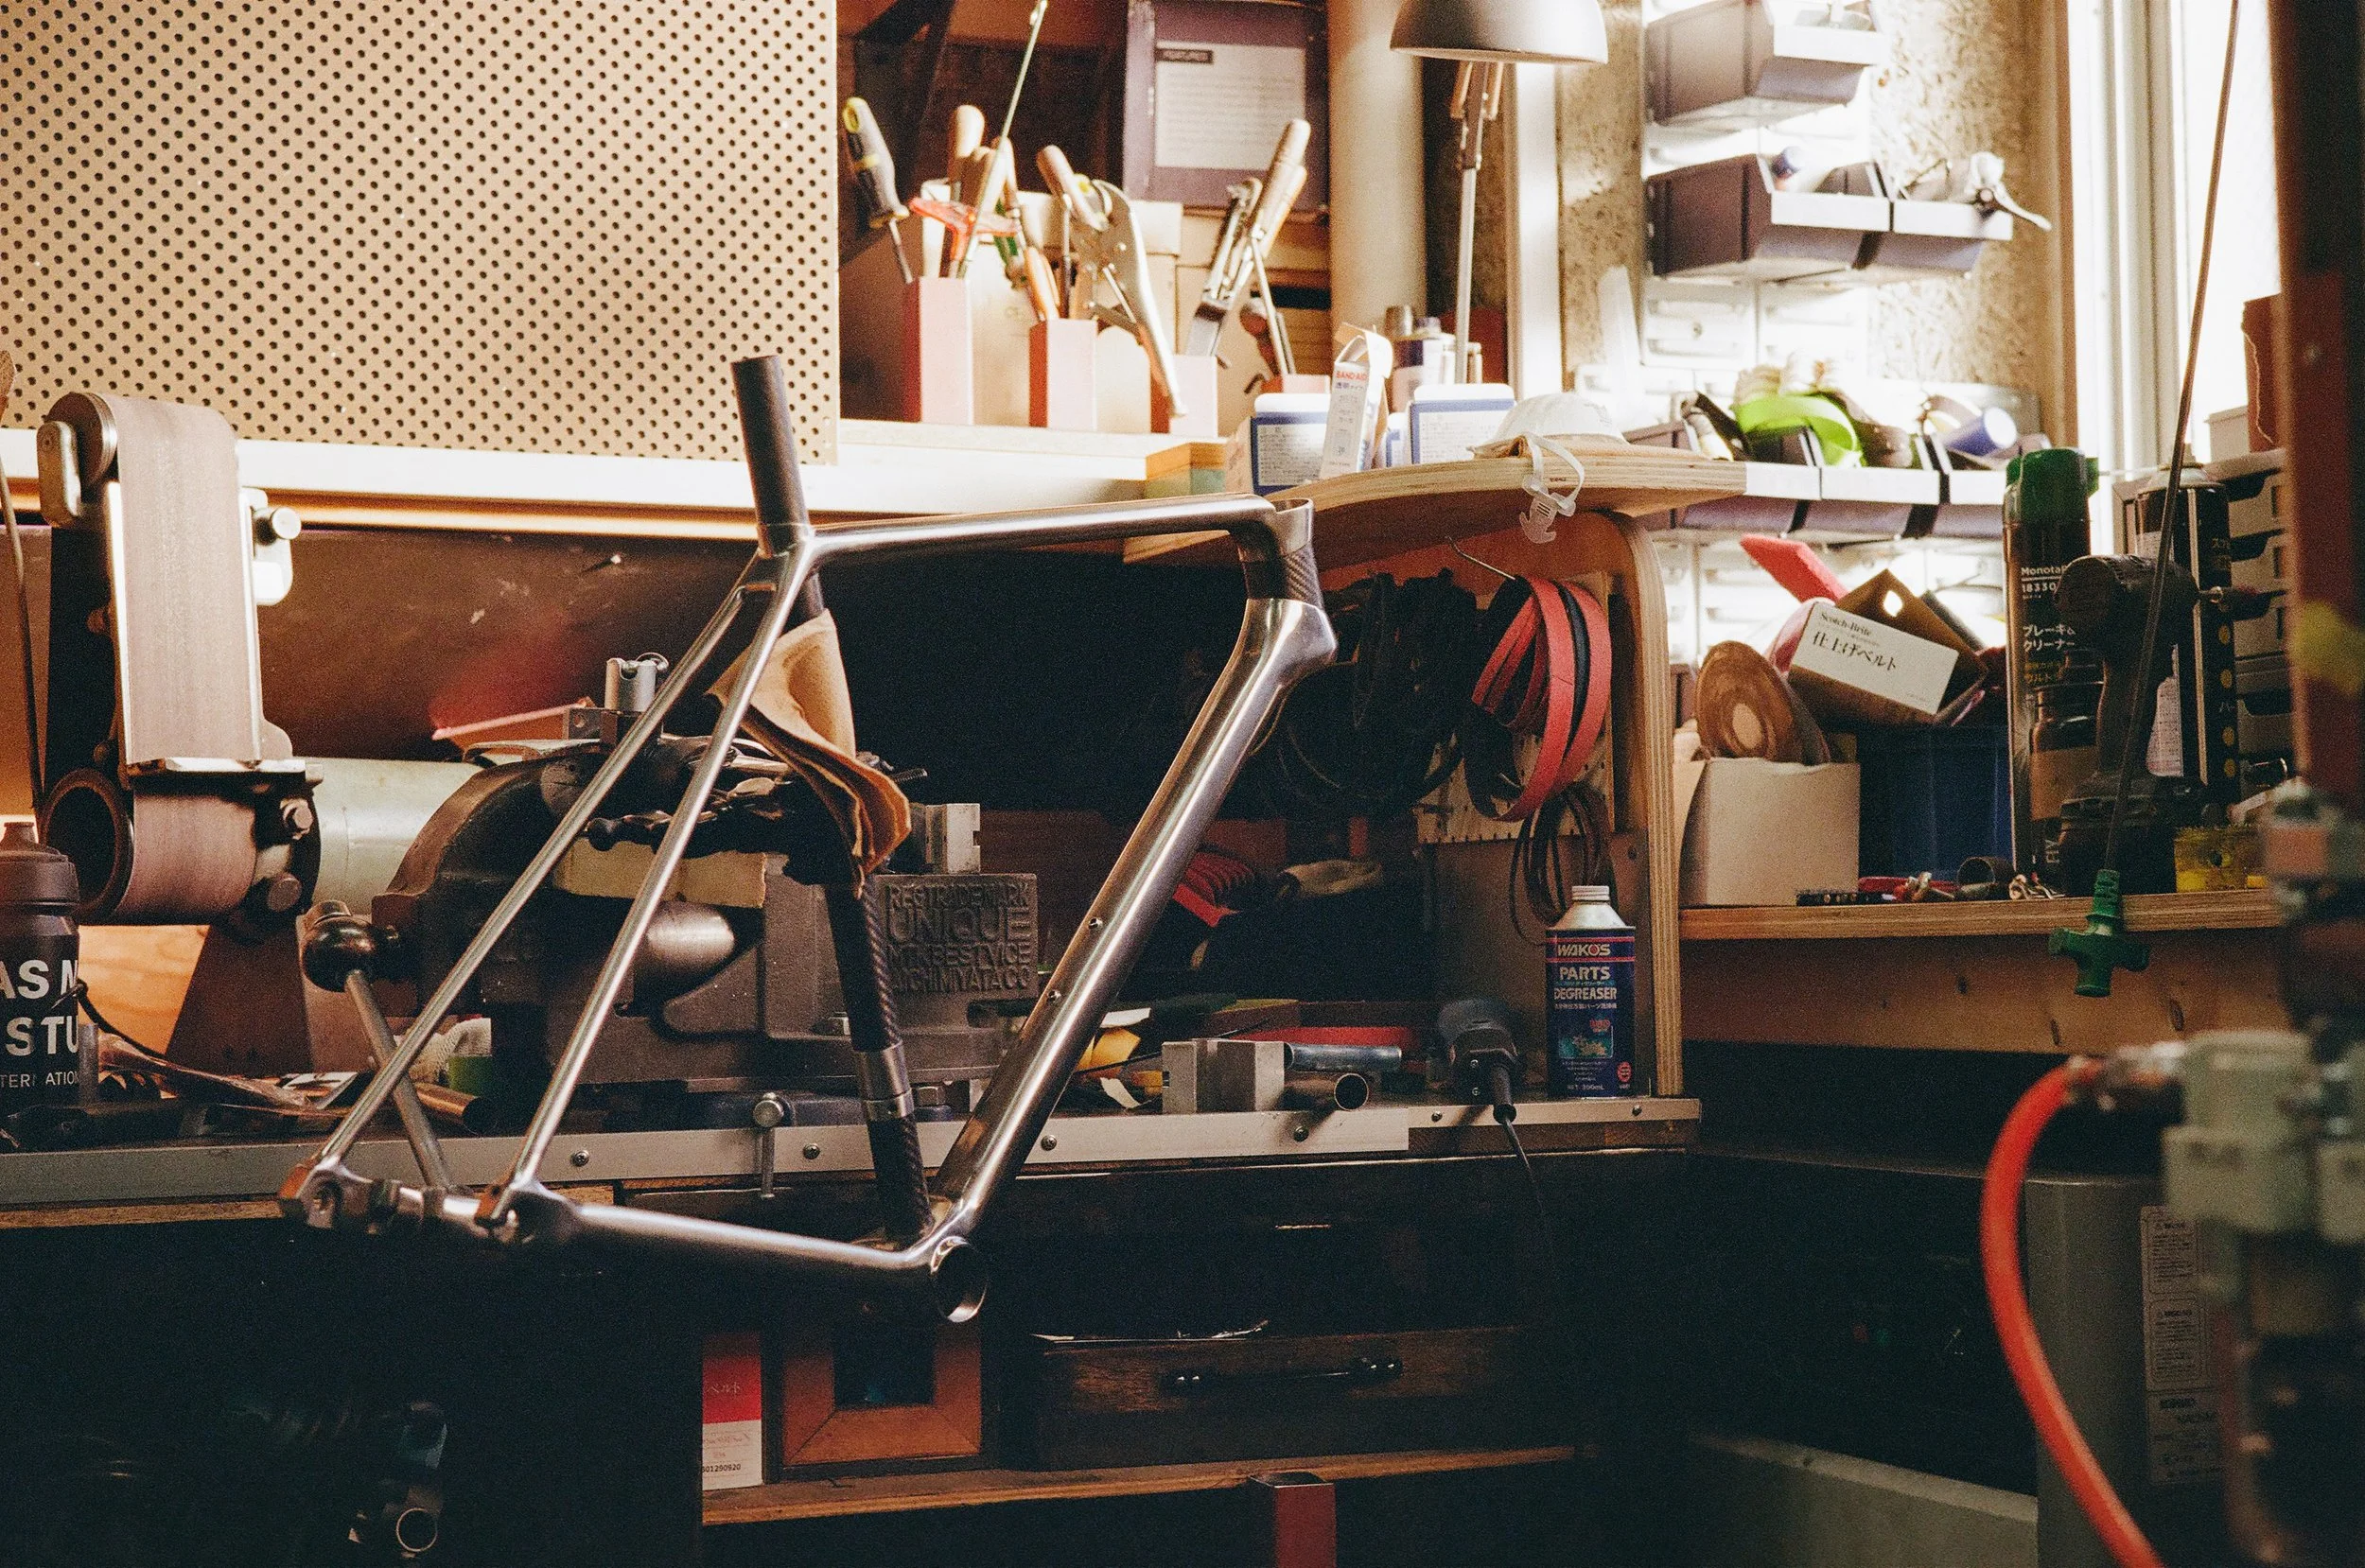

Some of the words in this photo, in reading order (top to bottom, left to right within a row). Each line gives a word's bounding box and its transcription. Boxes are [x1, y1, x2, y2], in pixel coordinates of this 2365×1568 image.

[1813, 631, 1897, 671] 仕上げベルト
[885, 906, 1032, 945] UNIQUE
[1559, 966, 1612, 981] PARTS
[1553, 986, 1618, 1001] DEGREASER
